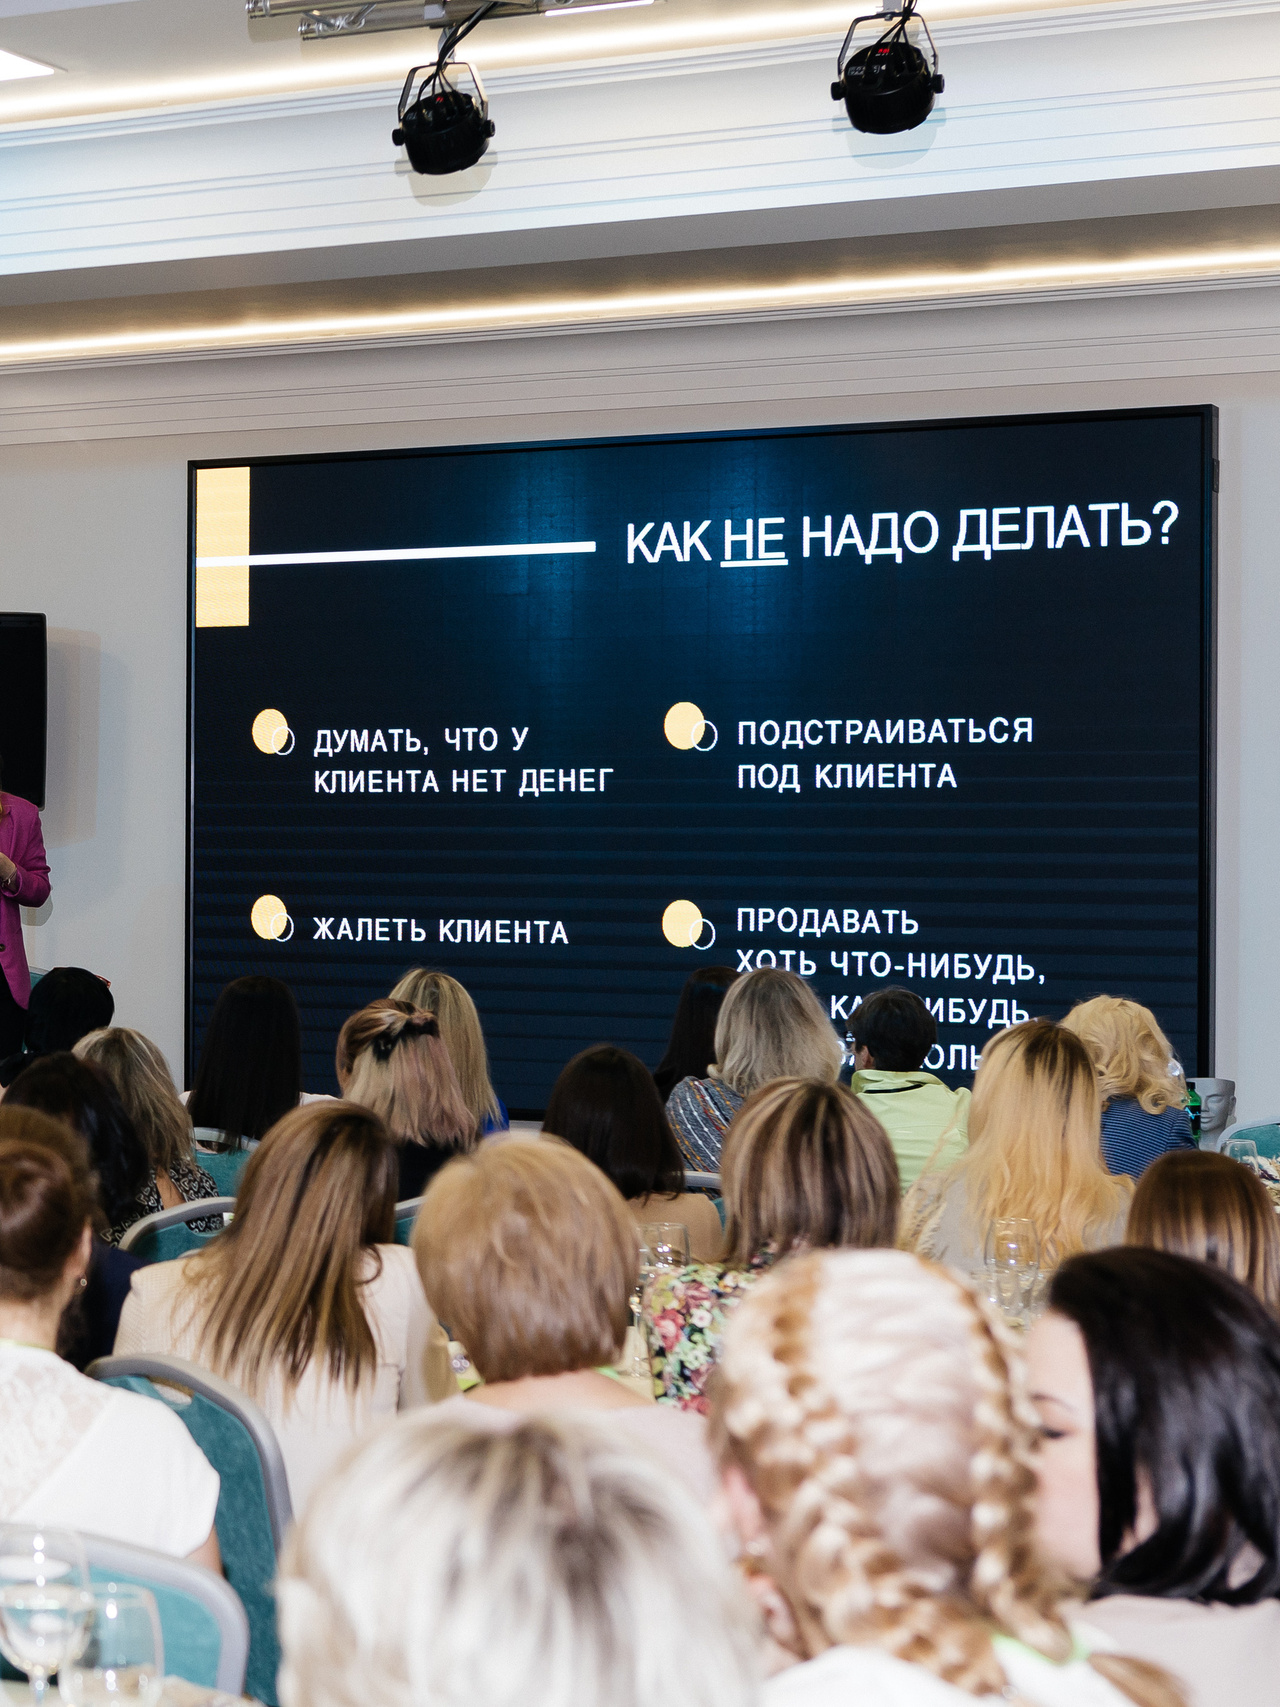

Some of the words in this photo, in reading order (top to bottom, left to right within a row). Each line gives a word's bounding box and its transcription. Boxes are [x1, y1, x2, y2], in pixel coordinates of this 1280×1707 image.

[627, 520, 713, 564] КАК
[723, 517, 787, 562] НЕ
[802, 511, 940, 564] НАДО
[952, 500, 1180, 562] ДЕЛАТЬ?
[313, 728, 429, 758] ДУМАТЬ,
[444, 727, 499, 751] ЧТО
[511, 727, 529, 751] У
[737, 717, 1034, 750] ПОДСТРАИВАТЬСЯ
[314, 769, 440, 794] КЛИЕНТА
[452, 768, 507, 793] НЕТ
[519, 768, 614, 797] ДЕНЕГ
[737, 764, 801, 793] ПОД
[815, 763, 958, 788] КЛИЕНТА
[313, 917, 427, 942] ЖАЛЕТЬ
[439, 919, 569, 944] КЛИЕНТА
[737, 907, 920, 938] ПРОДАВАТЬ
[736, 948, 817, 976] ХОТЬ
[830, 951, 1046, 985] ЧТО-НИБУДЬ,
